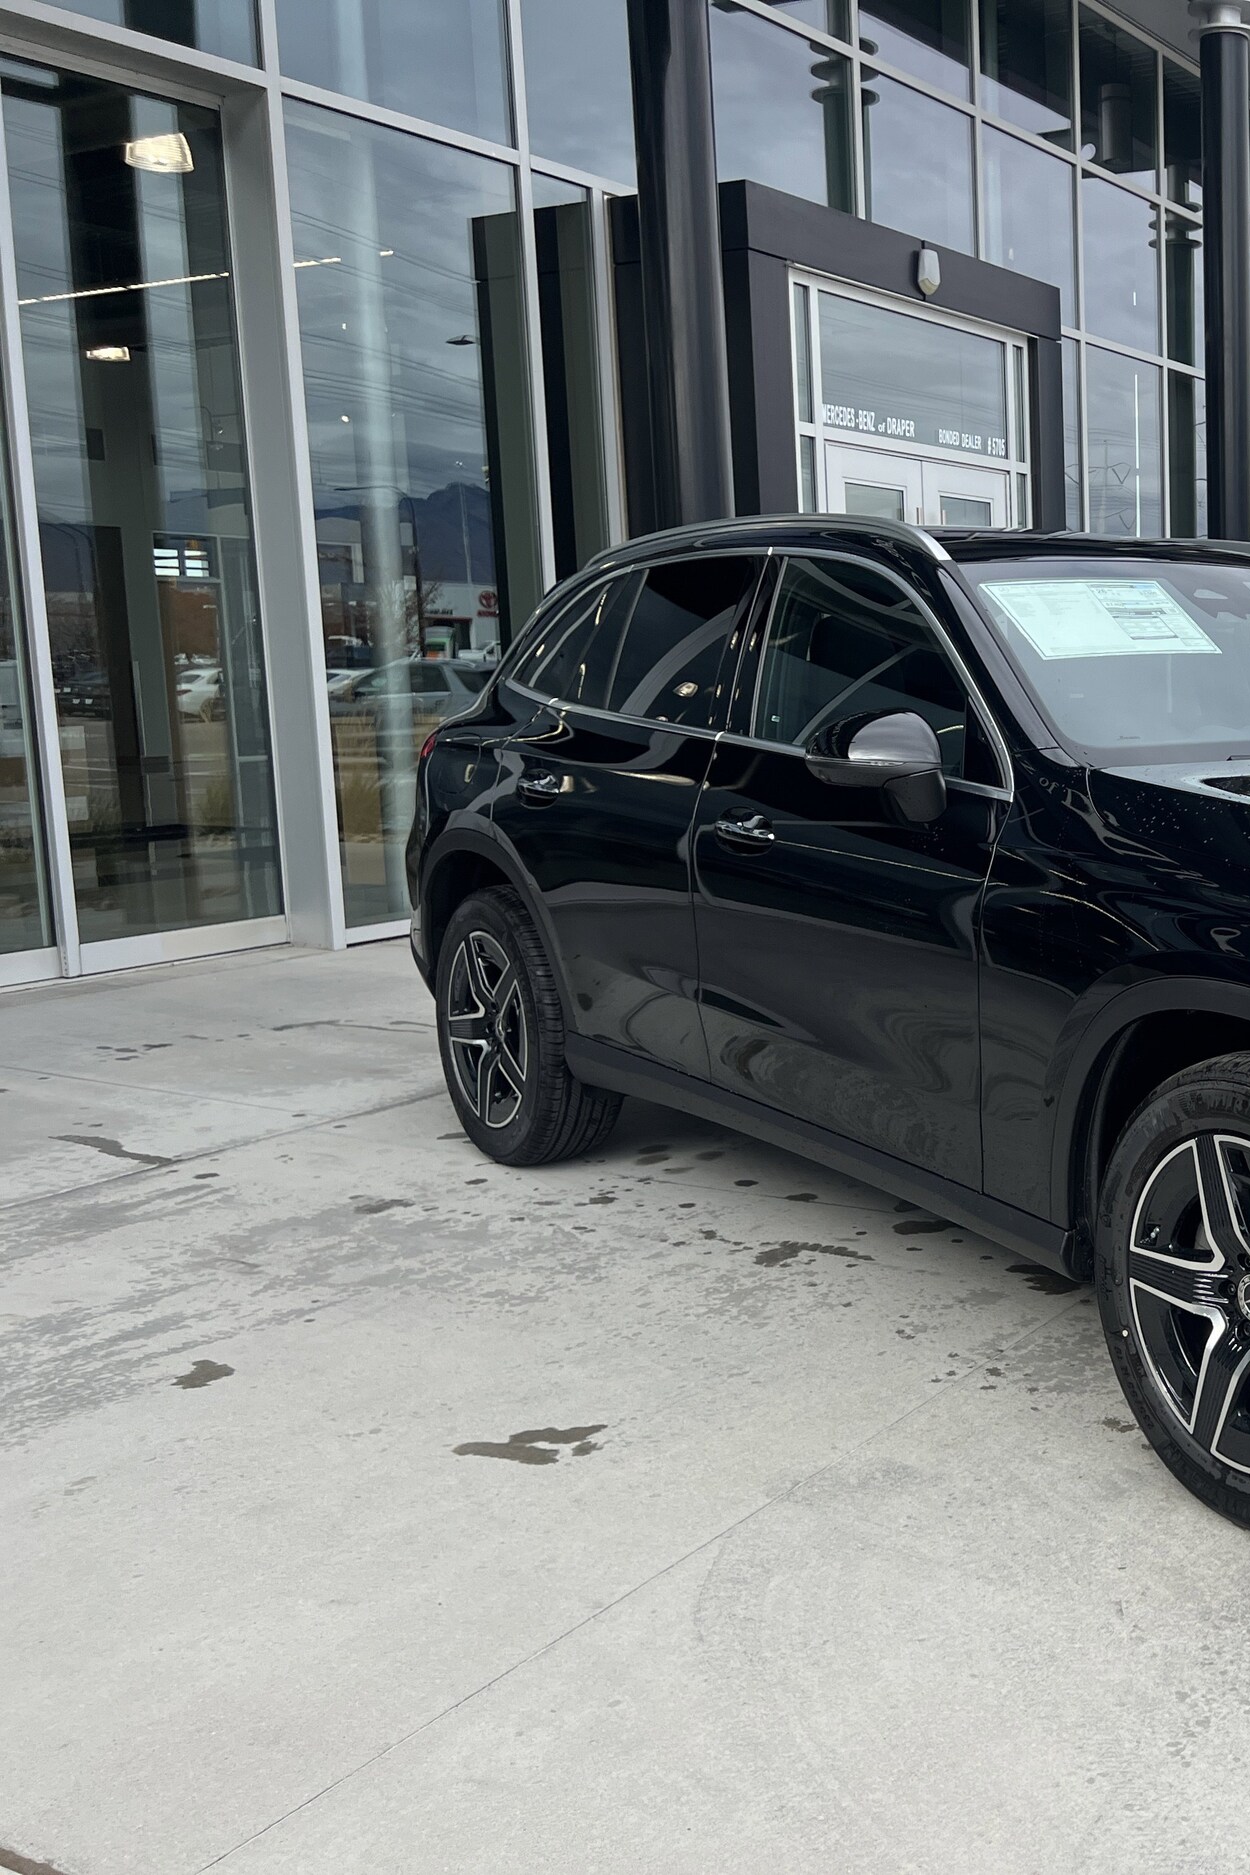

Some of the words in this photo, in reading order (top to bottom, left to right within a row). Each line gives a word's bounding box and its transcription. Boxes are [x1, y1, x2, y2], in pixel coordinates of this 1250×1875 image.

[887, 417, 915, 437] DRAPER
[939, 428, 960, 446] BONDED
[962, 433, 981, 450] DEALER
